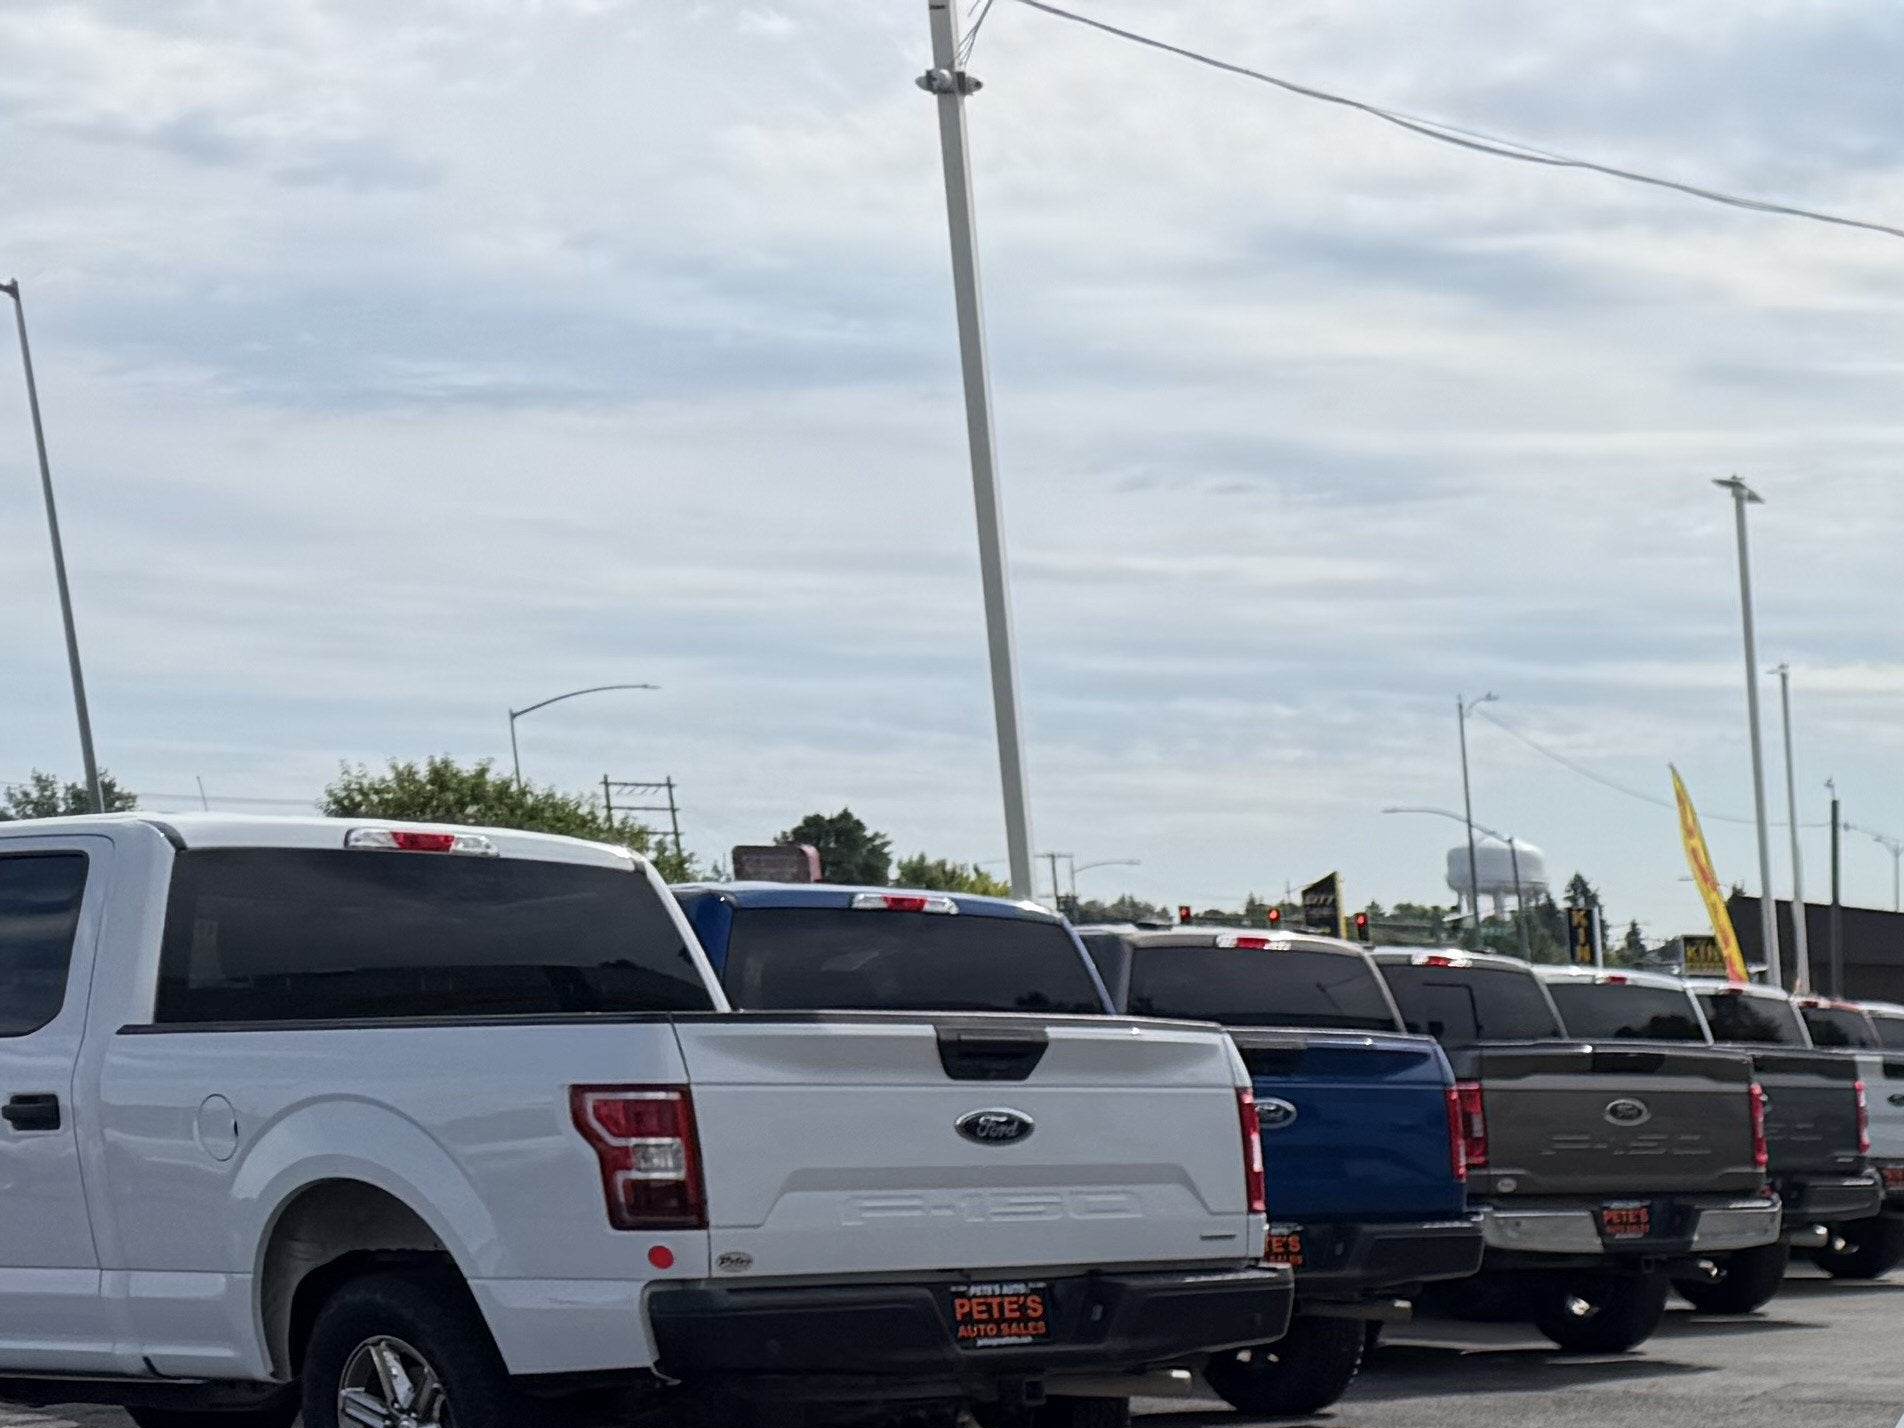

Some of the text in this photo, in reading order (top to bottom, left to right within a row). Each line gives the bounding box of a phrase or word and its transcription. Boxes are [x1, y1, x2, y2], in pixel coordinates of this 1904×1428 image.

[977, 1115, 1019, 1138] Ford
[842, 1191, 1145, 1226] F-150
[954, 1295, 1044, 1321] PETE'S
[958, 1321, 1046, 1338] AUTO SALES
